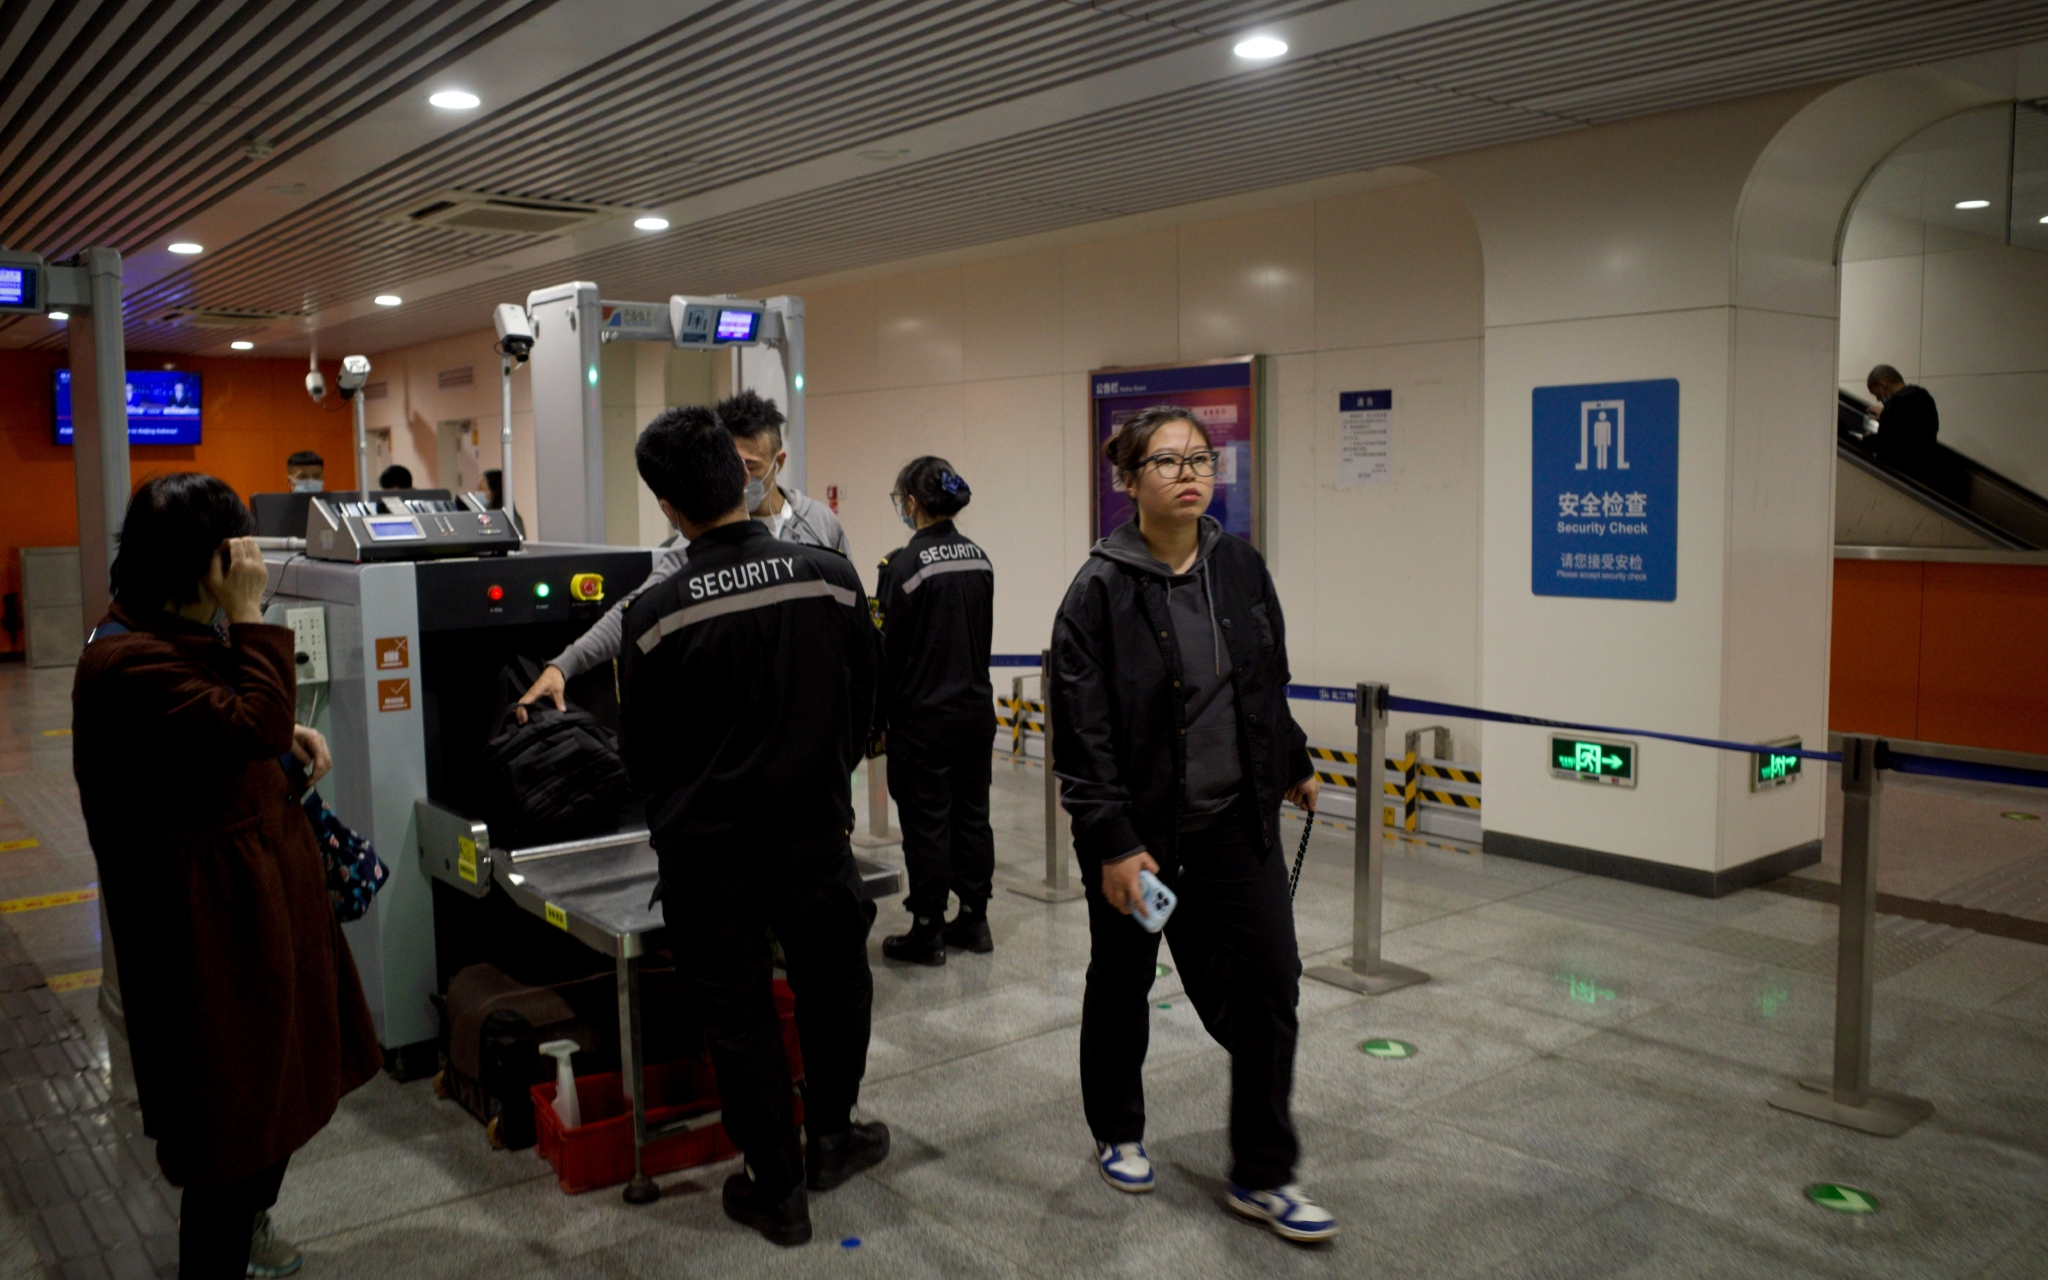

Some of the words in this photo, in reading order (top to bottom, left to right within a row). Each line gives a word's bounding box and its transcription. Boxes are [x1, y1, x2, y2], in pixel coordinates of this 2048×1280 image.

[1558, 491, 1648, 518] 安全检查
[1557, 521, 1606, 537] Security
[1609, 521, 1649, 535] Check
[919, 543, 982, 565] SECURITY
[1561, 552, 1642, 570] 请您接受安检
[689, 557, 794, 600] SECURITY
[1628, 573, 1647, 581] check
